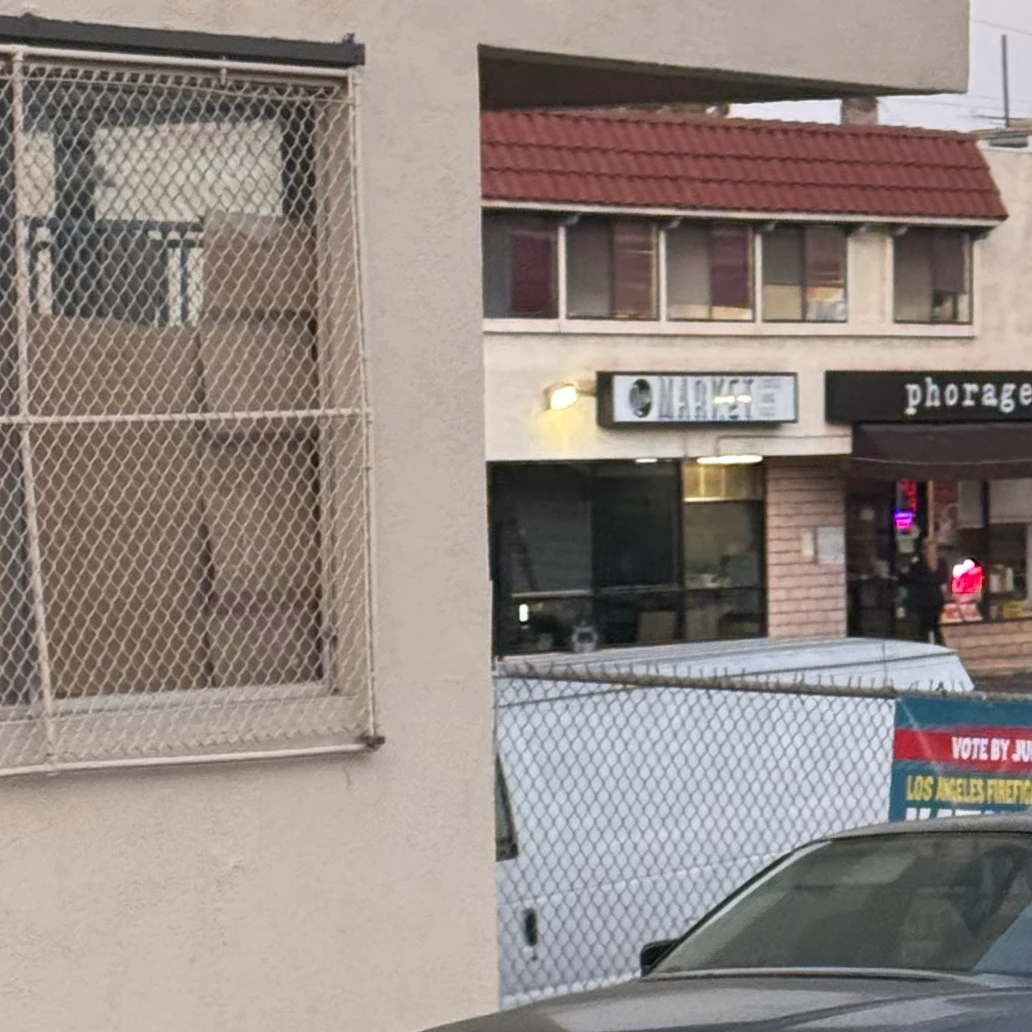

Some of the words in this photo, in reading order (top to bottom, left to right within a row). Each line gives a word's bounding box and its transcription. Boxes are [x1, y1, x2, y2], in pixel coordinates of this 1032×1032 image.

[951, 736, 989, 761] VOTE
[990, 737, 1011, 762] BY
[907, 775, 934, 801] LOS
[935, 776, 985, 803] ANGELES
